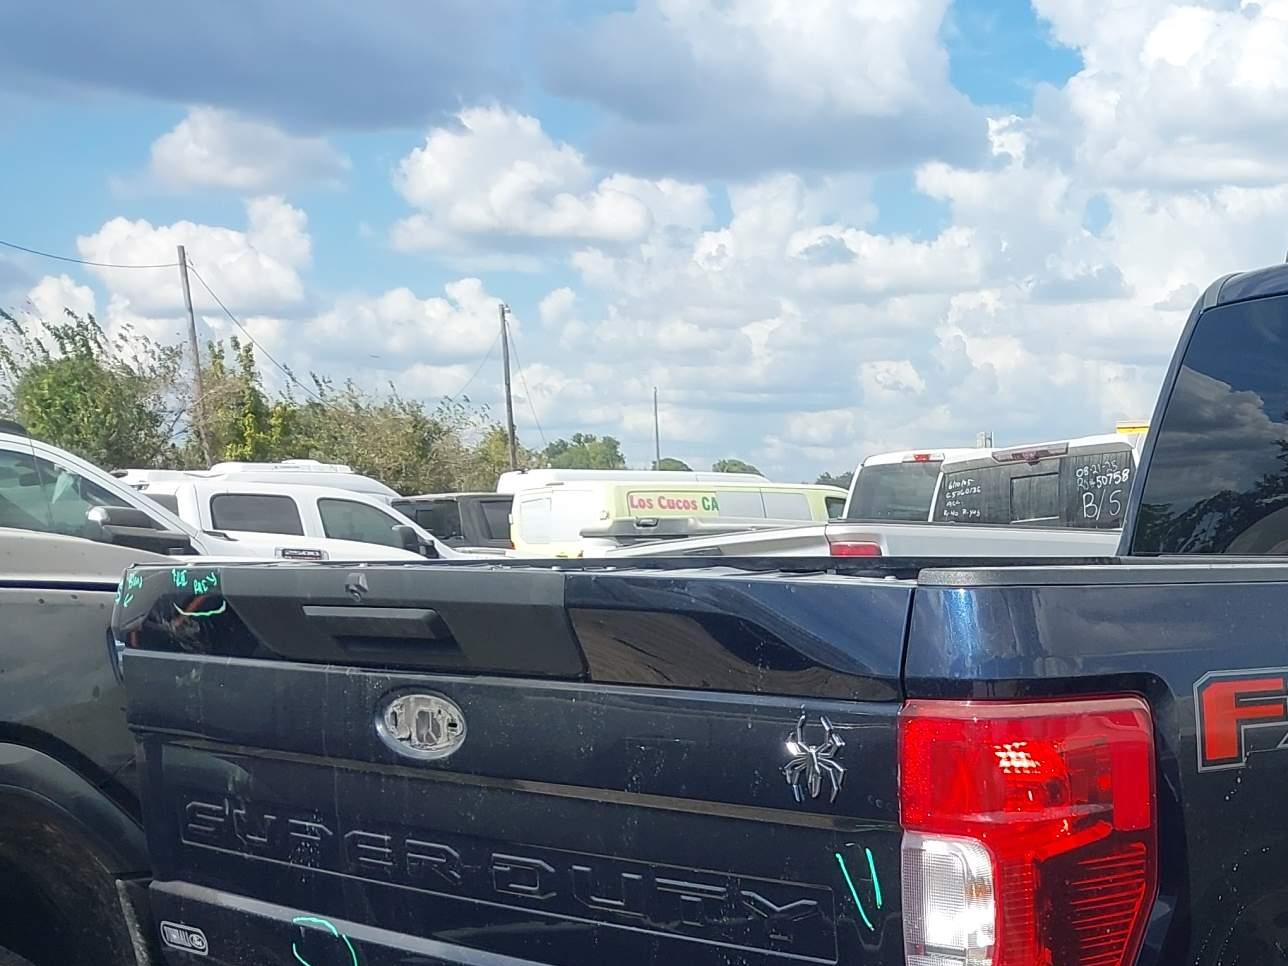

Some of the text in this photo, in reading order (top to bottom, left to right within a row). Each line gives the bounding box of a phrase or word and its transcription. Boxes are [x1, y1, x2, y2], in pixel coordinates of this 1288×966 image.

[629, 495, 654, 509] Los
[658, 496, 698, 511] Cucos
[184, 799, 820, 944] SUPER DUTY
